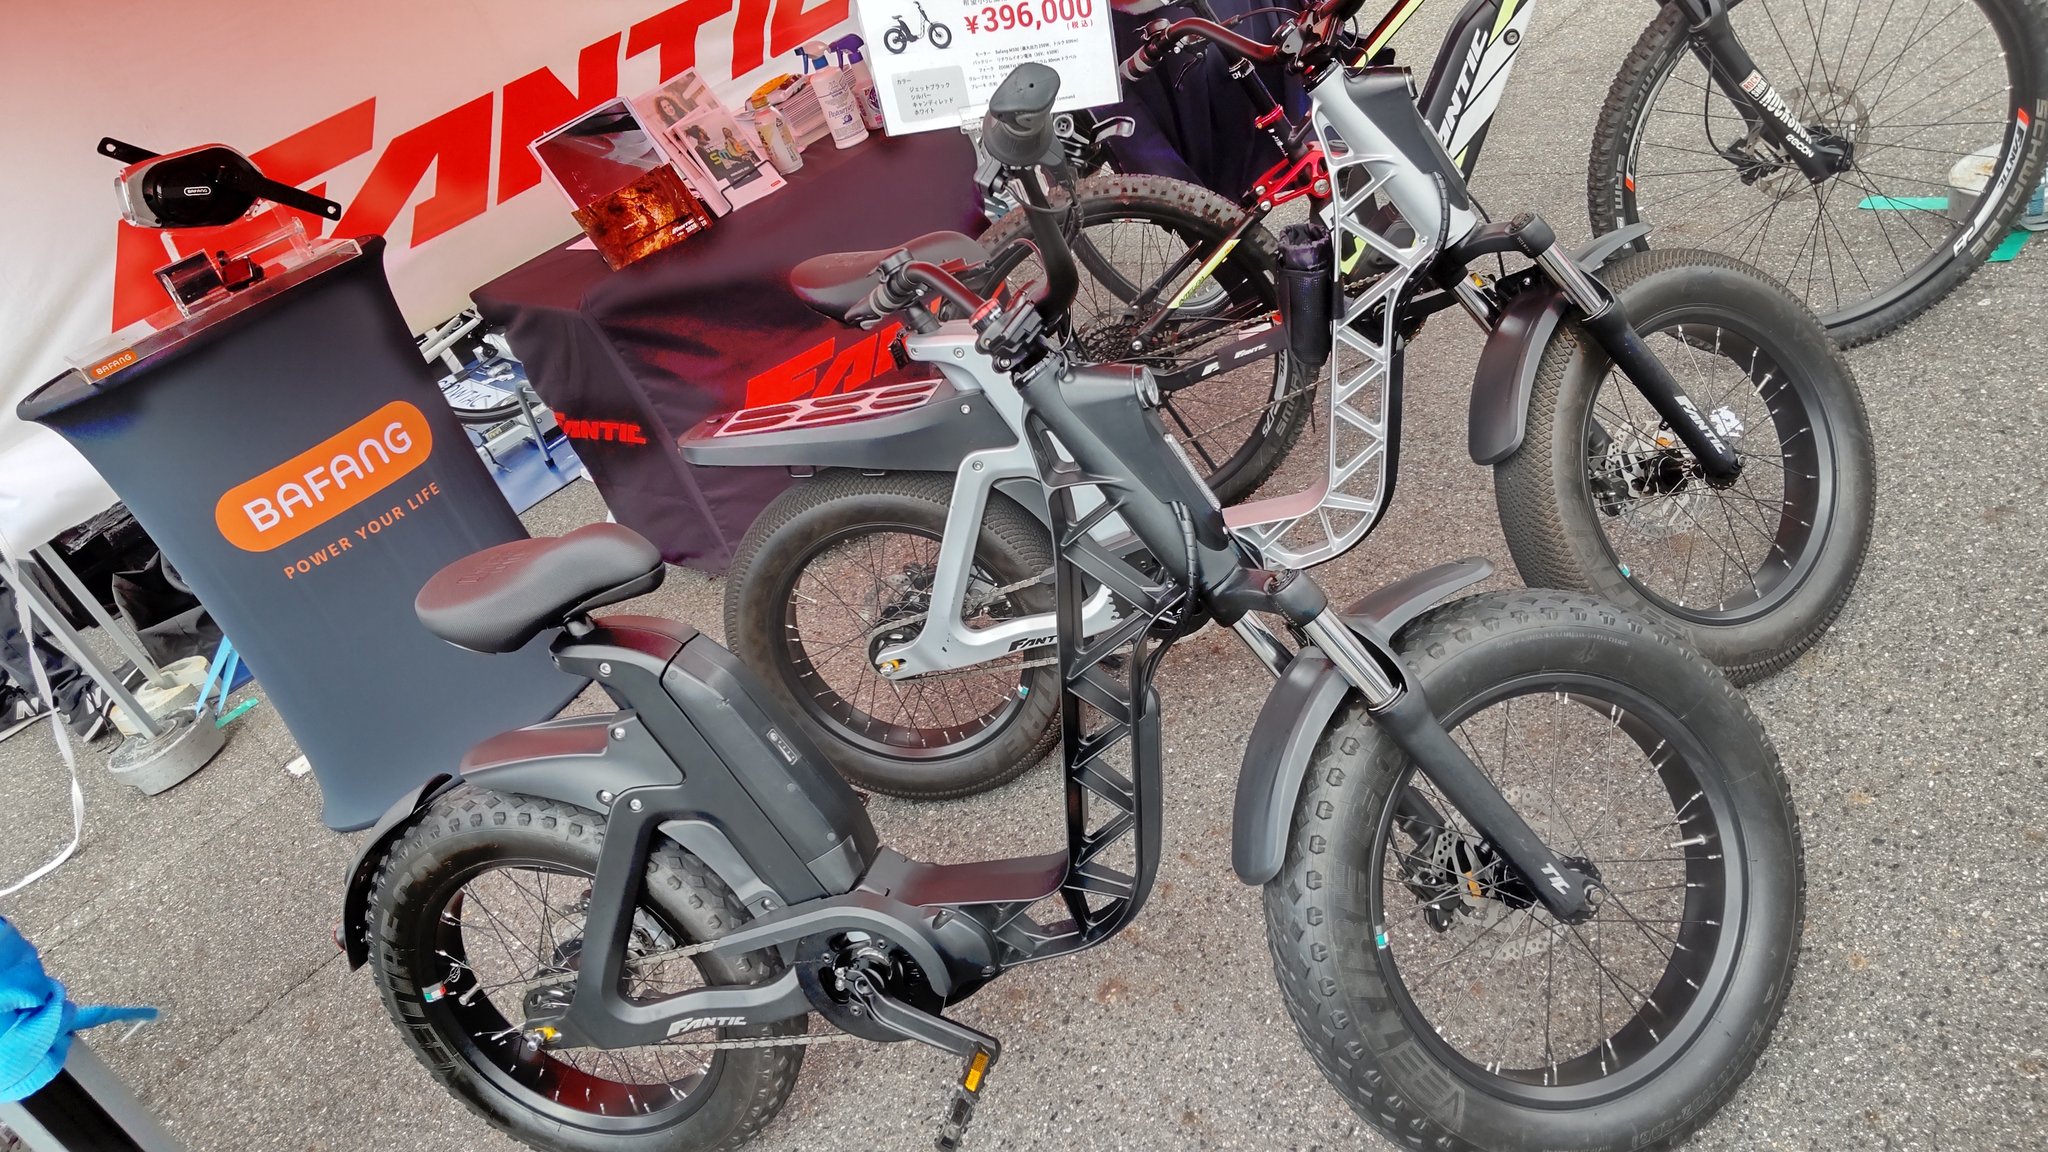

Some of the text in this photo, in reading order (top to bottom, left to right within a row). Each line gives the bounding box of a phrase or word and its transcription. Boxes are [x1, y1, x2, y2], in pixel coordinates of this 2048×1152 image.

[964, 0, 1093, 34] ¥396,000
[909, 82, 950, 92] ジェットブラック
[1437, 27, 1489, 148] ANTIC
[1743, 73, 1761, 91] ROCK
[910, 92, 932, 100] シルバー
[914, 107, 935, 116] ホワイト
[1785, 133, 1815, 158] RECON
[1997, 124, 2025, 190] FANTIC
[1970, 98, 2048, 258] SCHWALBE
[95, 353, 132, 375] BAFANG
[1674, 395, 1726, 455] FANTIC
[242, 421, 413, 533] BAFANG
[283, 481, 441, 580] POWER YOUR LIFE
[1008, 634, 1058, 653] FANT
[666, 1015, 748, 1037] FANTIC
